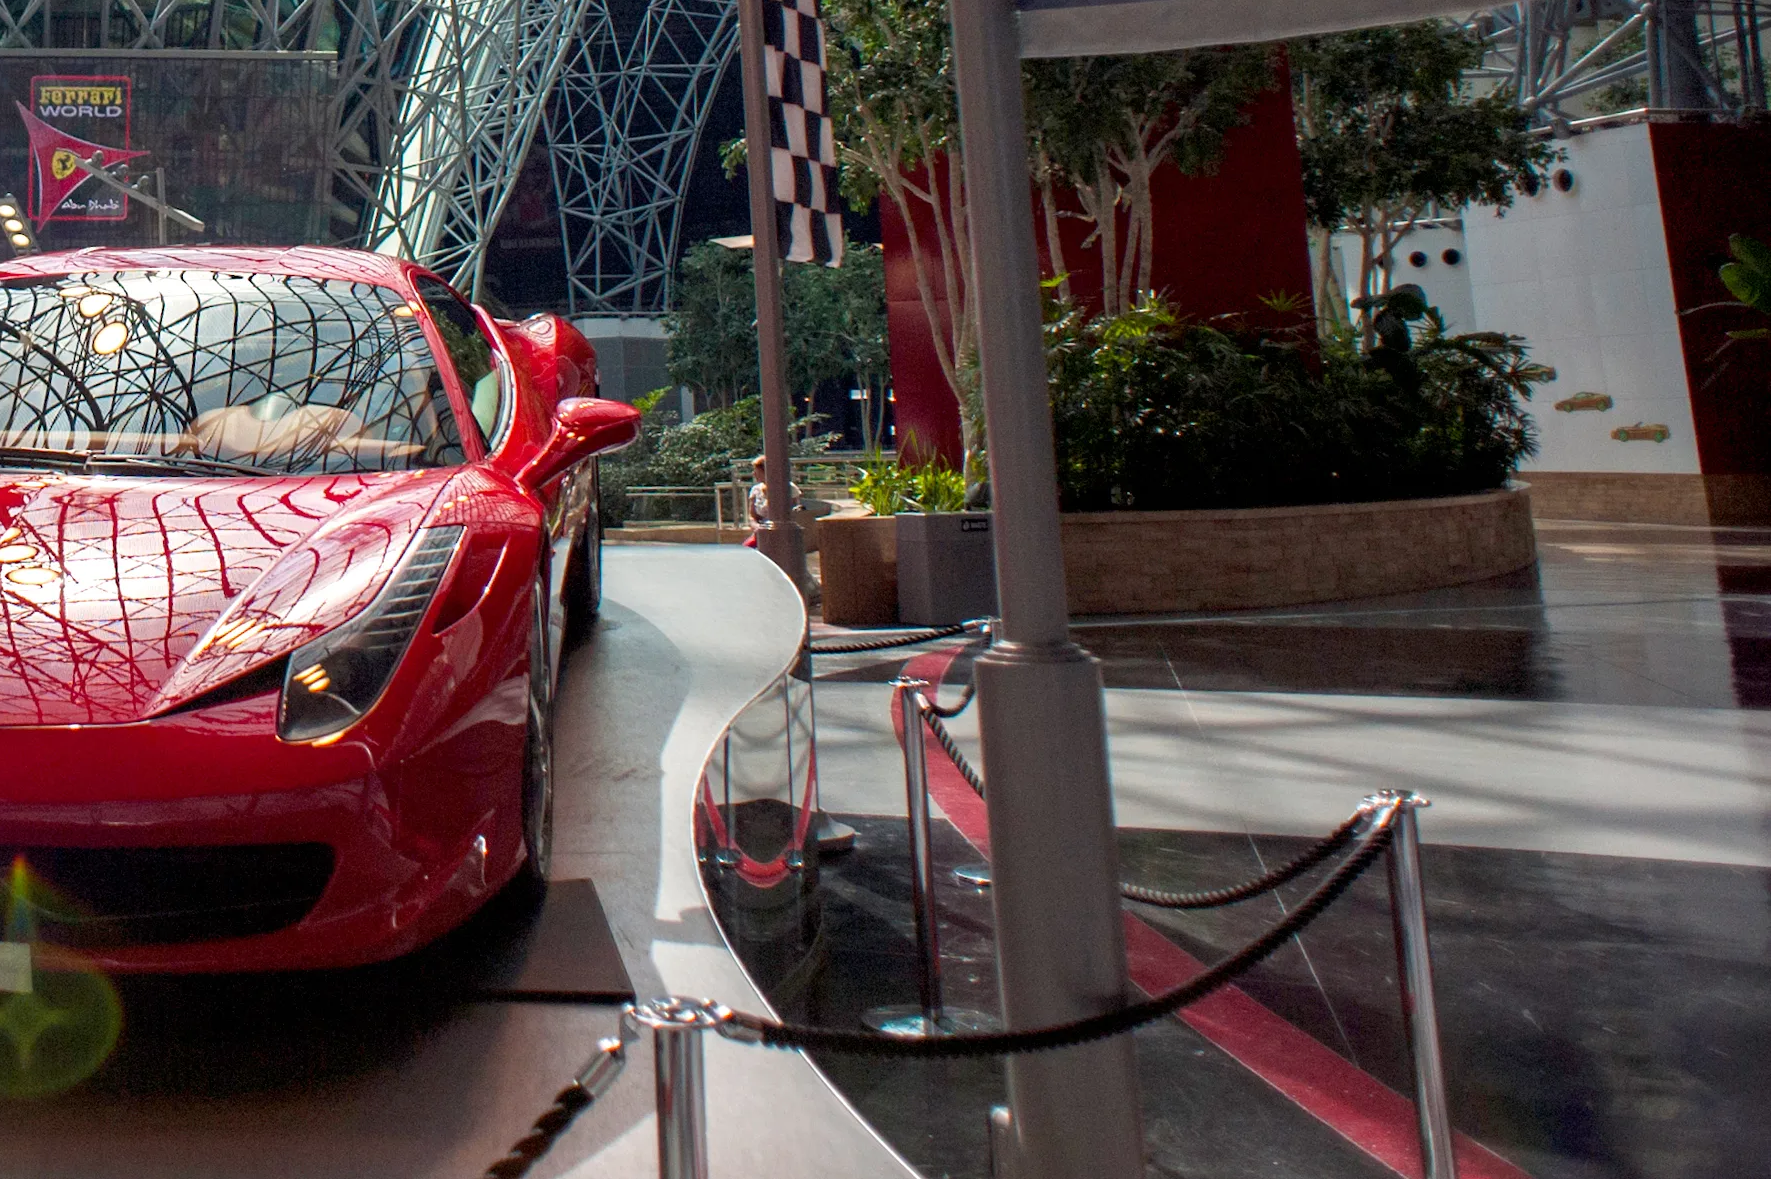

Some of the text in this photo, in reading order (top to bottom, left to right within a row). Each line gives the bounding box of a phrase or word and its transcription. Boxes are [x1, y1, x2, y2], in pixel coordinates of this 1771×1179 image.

[40, 86, 122, 105] Ferrari
[39, 105, 122, 118] WORLD
[61, 198, 119, 211] Abu Dhabi
